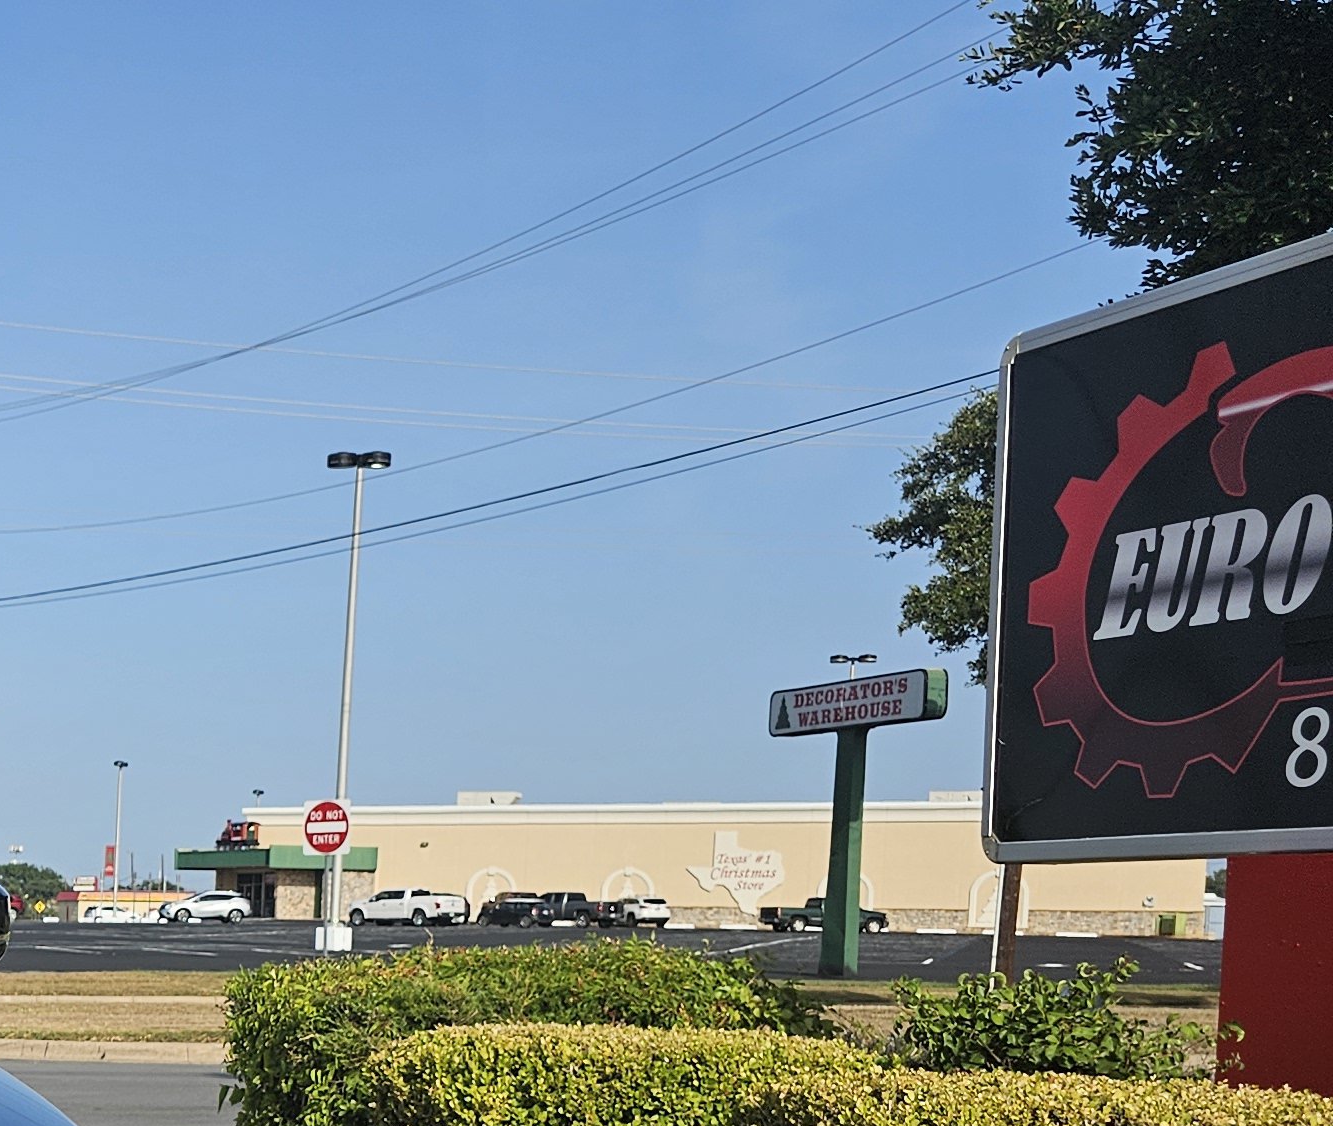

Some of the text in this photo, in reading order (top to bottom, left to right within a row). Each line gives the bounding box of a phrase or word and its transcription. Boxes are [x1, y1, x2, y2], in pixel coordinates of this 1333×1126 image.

[1093, 493, 1332, 640] EURO
[793, 677, 908, 708] DECORATOR'S
[797, 699, 902, 727] WAREHOUSE
[310, 809, 343, 821] DO NOT
[312, 834, 340, 845] ENTER
[755, 854, 771, 864] #1
[711, 866, 776, 880] Christmas
[734, 881, 764, 891] Store
